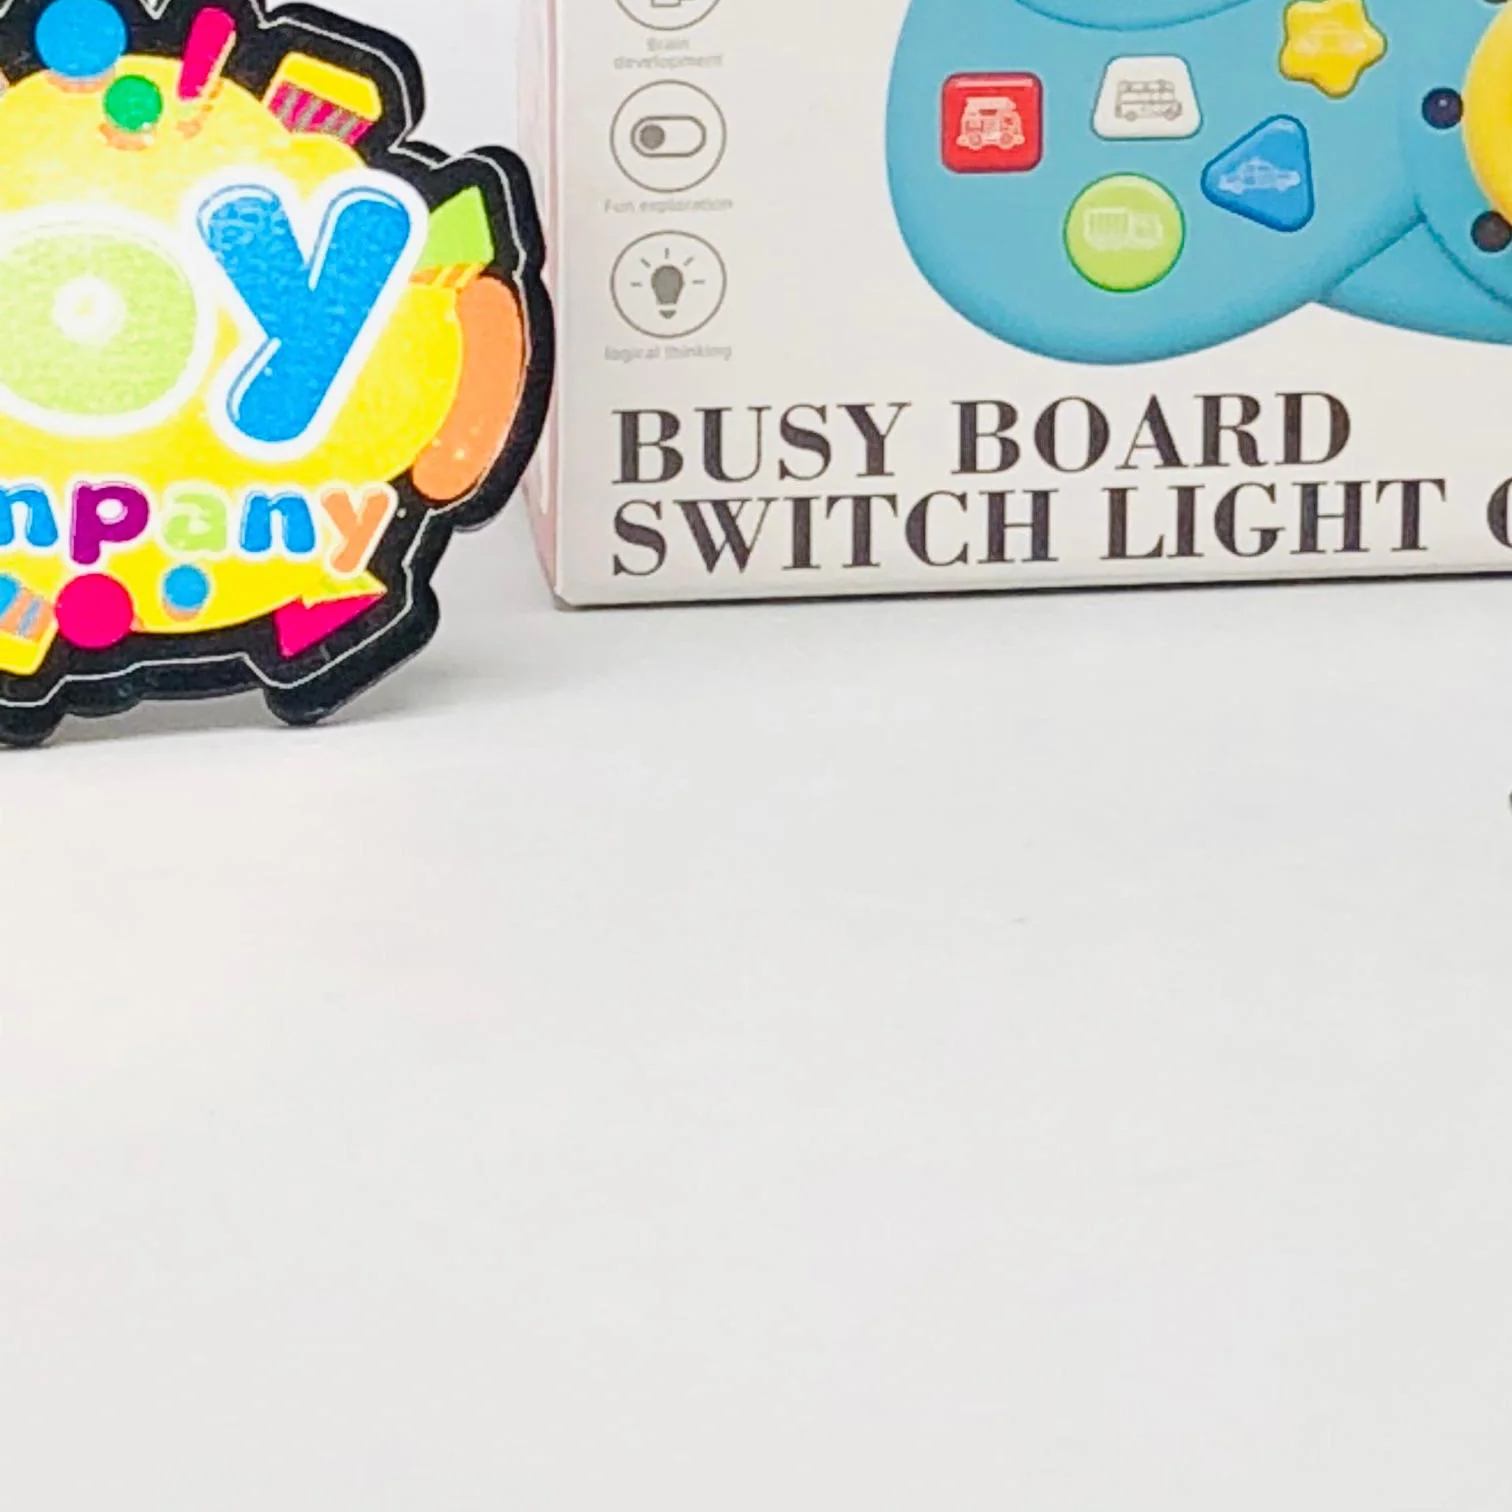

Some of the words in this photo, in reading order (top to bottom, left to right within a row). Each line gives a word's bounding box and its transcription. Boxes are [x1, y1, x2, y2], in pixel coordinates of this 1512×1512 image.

[611, 401, 911, 484] BUSY
[950, 391, 1352, 474] BOARD
[611, 488, 1060, 577] SWITCH
[1100, 478, 1447, 561] LIGHT
